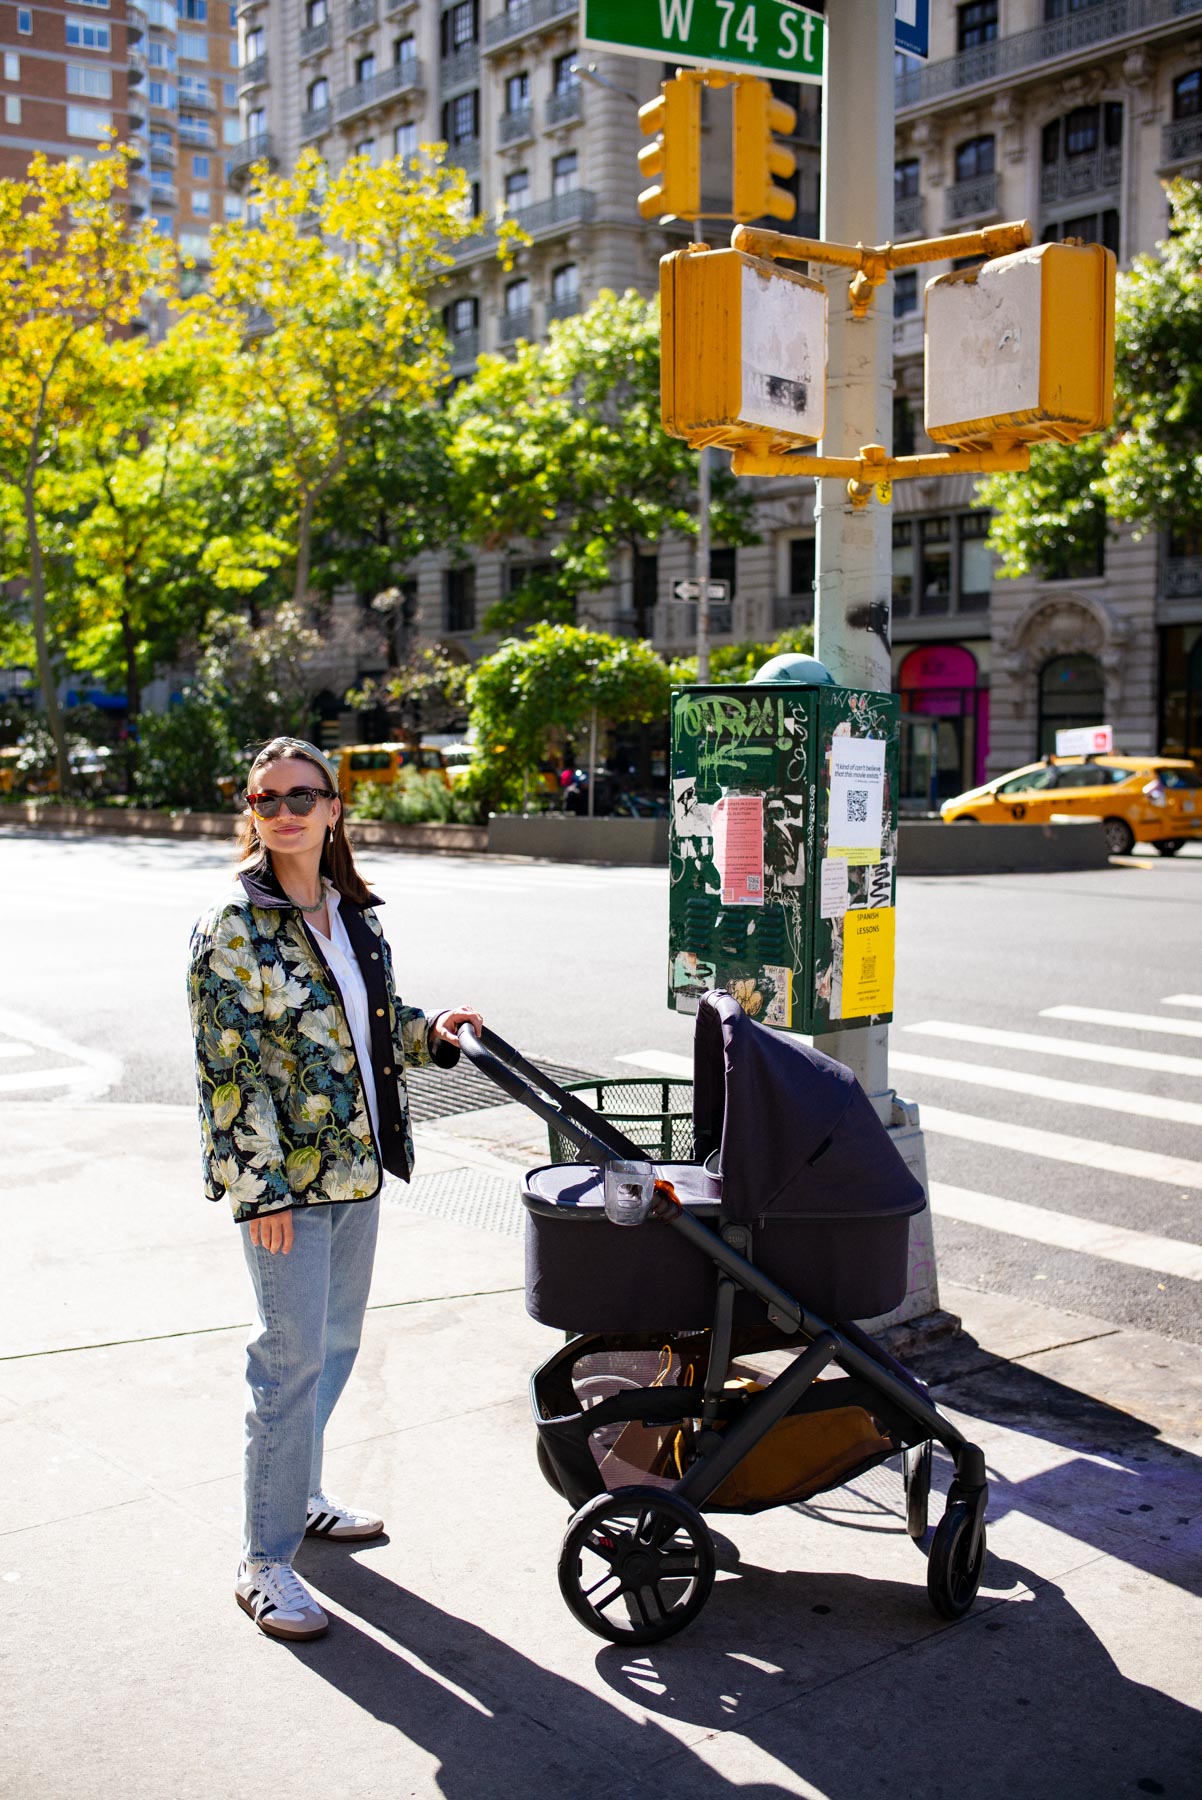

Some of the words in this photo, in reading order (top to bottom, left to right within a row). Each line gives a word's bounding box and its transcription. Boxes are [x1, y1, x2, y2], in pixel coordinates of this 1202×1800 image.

[659, 0, 694, 42] W
[716, 1, 758, 53] 74
[778, 11, 815, 62] St
[856, 912, 879, 921] SPANISH
[856, 925, 880, 935] LESSONS
